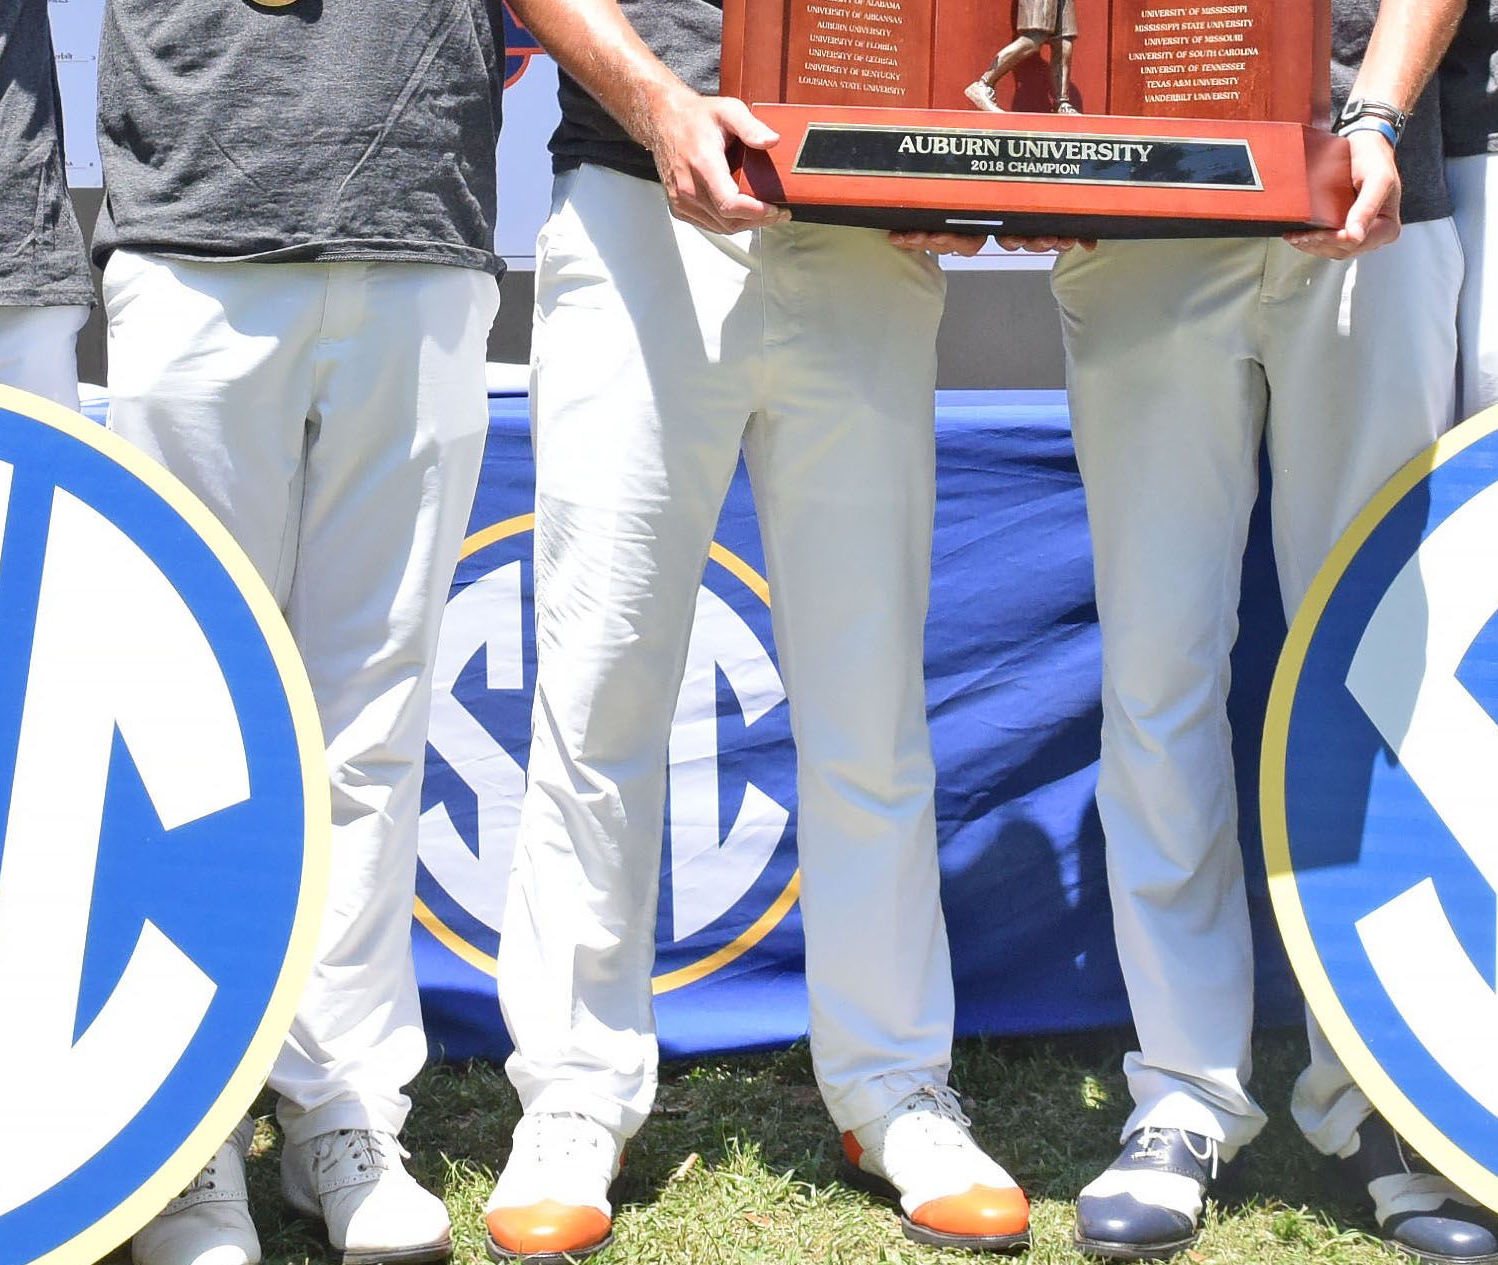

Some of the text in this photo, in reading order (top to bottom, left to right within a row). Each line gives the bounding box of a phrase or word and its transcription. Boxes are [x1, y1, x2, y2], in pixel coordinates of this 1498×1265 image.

[866, 0, 901, 10] ALABAMA
[1141, 5, 1247, 17] UNIVERSITY OF MISSISSIPPI
[807, 5, 902, 24] UNIVERSITY OF ARKANSAS
[817, 21, 892, 37] AUBURN UNIVERSITY
[1135, 19, 1254, 32] MISSISSIPPI STATE UNIVERSITY
[810, 34, 898, 52] UNIVERSITY OF FLORIDA
[1144, 34, 1243, 46] UNIVERSITY OF MISSOURI
[809, 48, 852, 61] UNIVERSITY
[865, 55, 898, 66] GEORGIA
[1129, 47, 1259, 61] UNIVERSITY OF SOUTH CAROLINA
[805, 62, 901, 81] UNIVERSITY OF KENTUCKY
[1140, 63, 1246, 75] UNIVERSITY OF TENNESSEE
[799, 76, 906, 96] LOUISIANA STATE UNIVERSITY
[1147, 77, 1239, 89] TEXAS A&M UNIVERSITY
[1144, 92, 1240, 103] VANDERBILT UNIVERSITY
[898, 135, 1153, 163] AUBURN UNIVERSITY
[971, 160, 1081, 175] 2018 CHAMPION
[417, 558, 791, 944] SC
